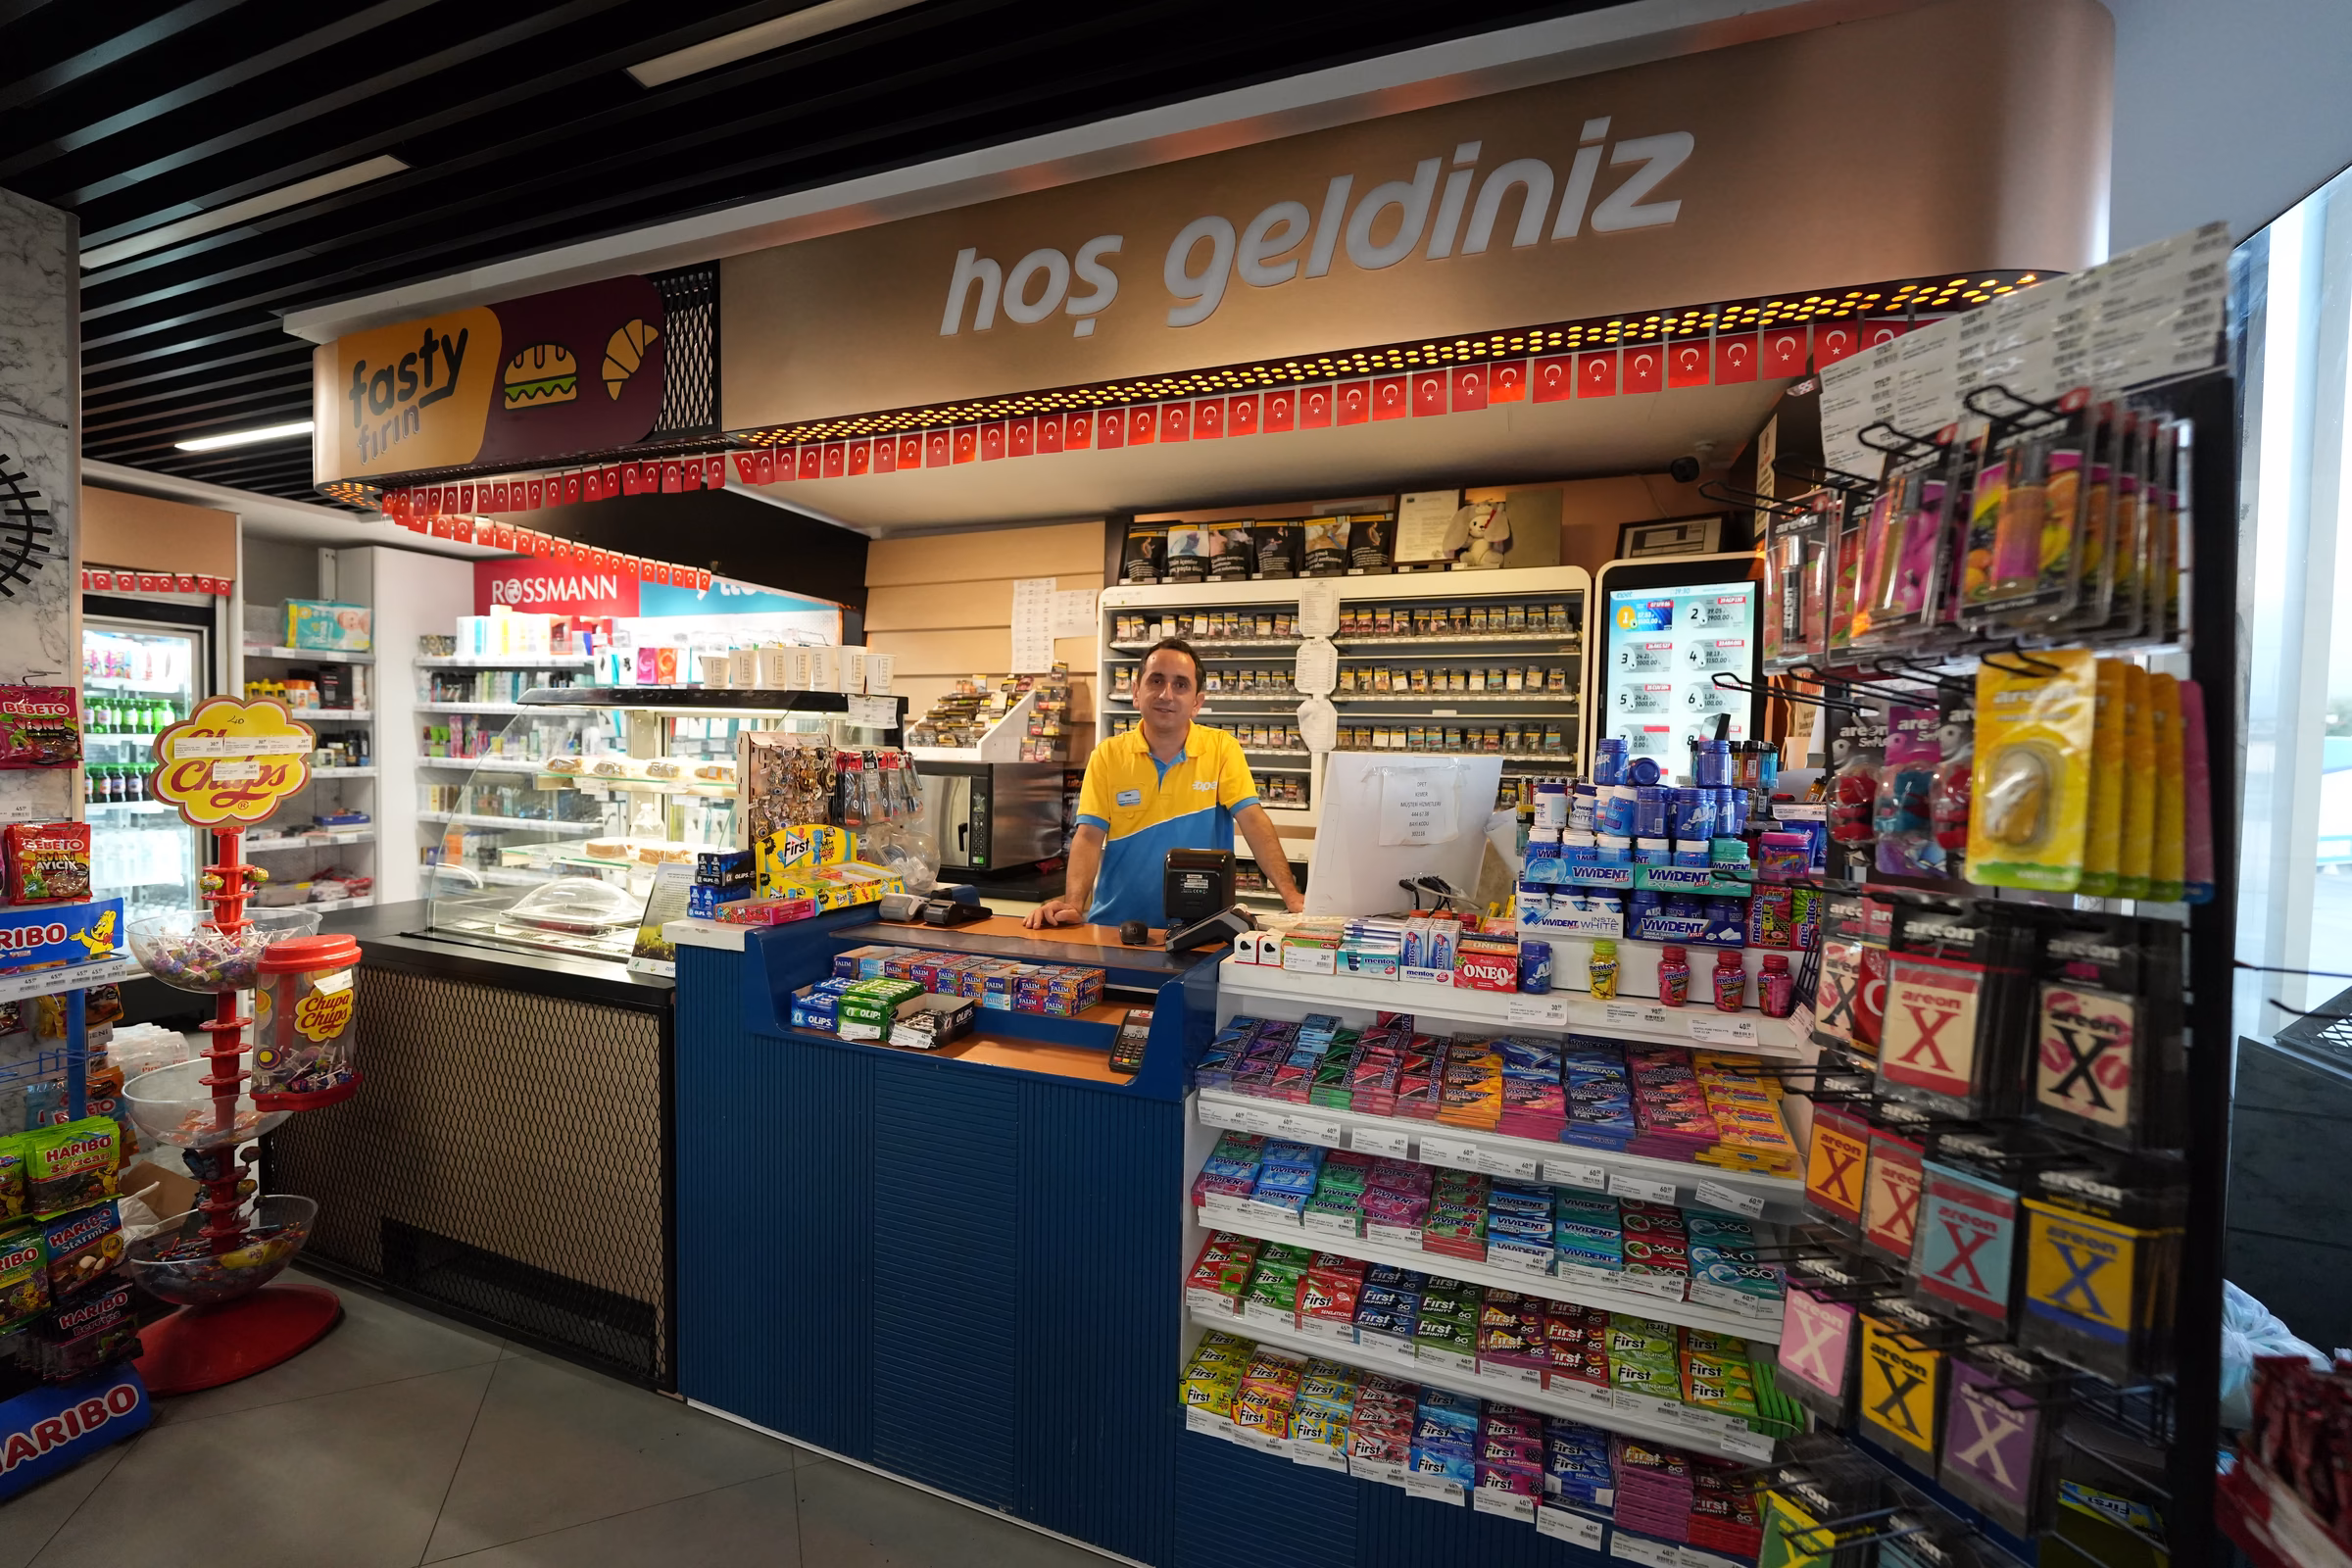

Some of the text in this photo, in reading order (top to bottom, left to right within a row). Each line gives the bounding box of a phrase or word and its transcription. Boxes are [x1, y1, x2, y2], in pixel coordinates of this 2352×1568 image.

[940, 115, 1694, 338] hoş geldiniz
[349, 327, 468, 428] fasty
[492, 574, 617, 605] ROSSMANN
[1623, 612, 1629, 623] 1
[1690, 609, 1698, 619] 2
[1621, 653, 1628, 664] 3
[1690, 651, 1696, 662] 4
[1620, 694, 1627, 705] 5
[1689, 693, 1695, 704] 6
[3, 702, 70, 715] BEBETO
[1595, 755, 1610, 764] AIR
[22, 838, 84, 851] BEBETO
[785, 838, 809, 857] First
[1645, 907, 1661, 916] AIR
[1581, 921, 1619, 931] WHITE
[1752, 895, 1763, 944] mentos
[1903, 919, 1976, 942] areon
[2047, 938, 2120, 960] areon
[1463, 964, 1509, 980] ONEO
[1590, 962, 1617, 971] mentos
[305, 994, 350, 1012] Chupa
[1019, 997, 1037, 1005] FALIM
[1820, 971, 1857, 1031] X
[1900, 989, 1961, 1009] areon
[301, 1007, 348, 1035] Chups
[2049, 1009, 2122, 1034] areon
[1896, 1004, 1961, 1073] X
[2047, 1023, 2117, 1113] X
[46, 1135, 113, 1163] HARIBO
[1820, 1132, 1862, 1155] areon
[1881, 1164, 1920, 1185] areo
[2037, 1170, 2123, 1201] areon
[1650, 1217, 1683, 1228] 360
[1937, 1204, 1998, 1234] areon
[49, 1208, 113, 1248] HARIBO
[61, 1224, 110, 1252] Starmix
[2046, 1223, 2119, 1255] areon
[1934, 1219, 1995, 1297] X
[1738, 1266, 1775, 1280] 360
[2043, 1237, 2118, 1320] X
[1428, 1275, 1459, 1288] First
[59, 1292, 127, 1329] HARIBO
[1423, 1298, 1455, 1310] First
[1790, 1290, 1844, 1329] areon
[1484, 1311, 1516, 1324] First
[1419, 1321, 1452, 1334] First
[1549, 1325, 1583, 1338] First
[1490, 1334, 1522, 1347] First
[1613, 1336, 1645, 1348] First
[1687, 1337, 1718, 1349] First
[1786, 1307, 1844, 1389] X
[1868, 1340, 1928, 1380] areon
[1618, 1367, 1651, 1380] First
[1690, 1363, 1723, 1377] First
[1691, 1384, 1726, 1398] First
[1869, 1353, 1927, 1440] X
[1427, 1394, 1454, 1405] First
[1419, 1424, 1450, 1437] First
[1487, 1423, 1517, 1435] First
[1550, 1442, 1584, 1454] First
[1953, 1395, 2025, 1492] X
[1485, 1446, 1515, 1457] First
[1418, 1459, 1446, 1473] First
[1553, 1458, 1584, 1471] First
[1485, 1476, 1513, 1490] First
[1779, 1468, 1830, 1515] areon
